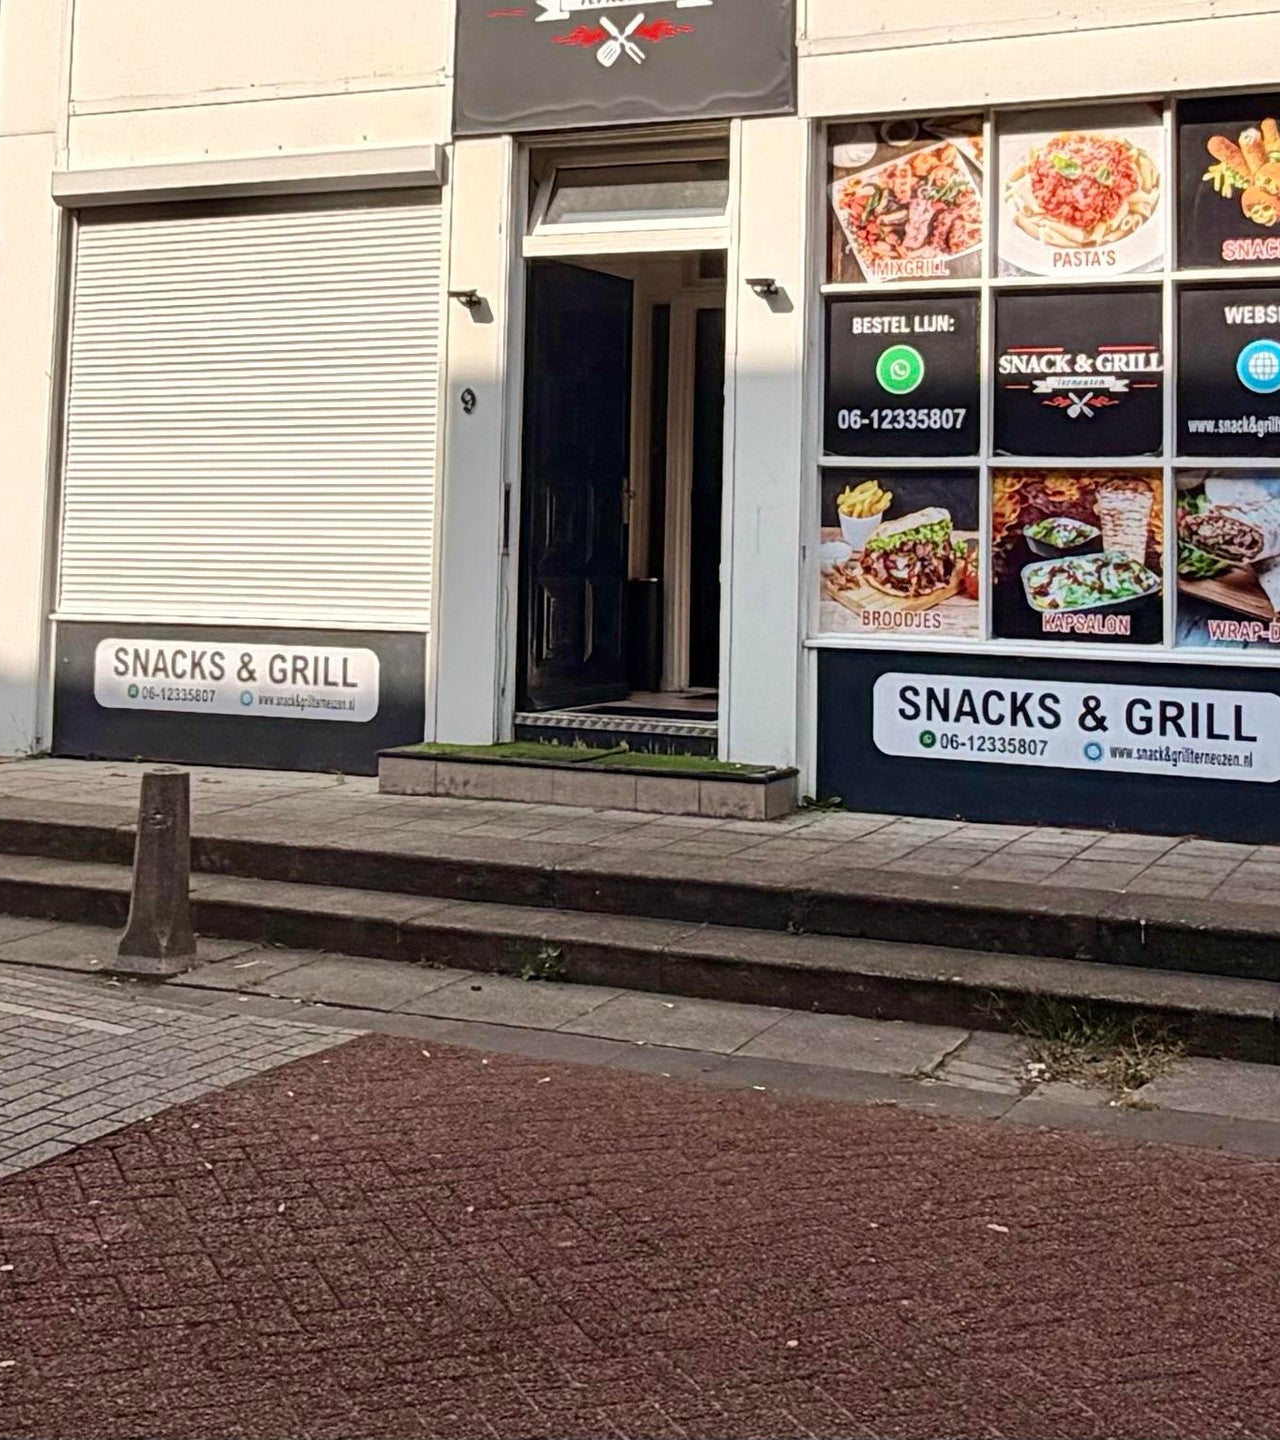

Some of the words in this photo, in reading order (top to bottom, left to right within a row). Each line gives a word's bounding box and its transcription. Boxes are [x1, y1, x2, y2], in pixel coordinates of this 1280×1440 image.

[875, 259, 950, 276] MIXGRILL
[1052, 248, 1117, 269] PASTA'S
[851, 315, 911, 335] BESTEL
[913, 313, 956, 333] LIJN:
[998, 353, 1072, 375] SNACK
[1073, 353, 1094, 374] &
[1095, 352, 1164, 373] GRILL
[460, 387, 477, 415] 9
[836, 408, 967, 431] 06-12335807
[862, 609, 942, 629] BROODJES
[1042, 613, 1132, 636] KAPSALON
[113, 646, 226, 682] SNACKS
[236, 651, 258, 683] &
[269, 652, 359, 688] GRILL
[141, 686, 217, 703] 06-12335807
[897, 685, 1062, 730] SNACKS
[1077, 694, 1109, 733] &
[1124, 697, 1259, 743] GRILL
[938, 732, 1049, 757] 06-12335807
